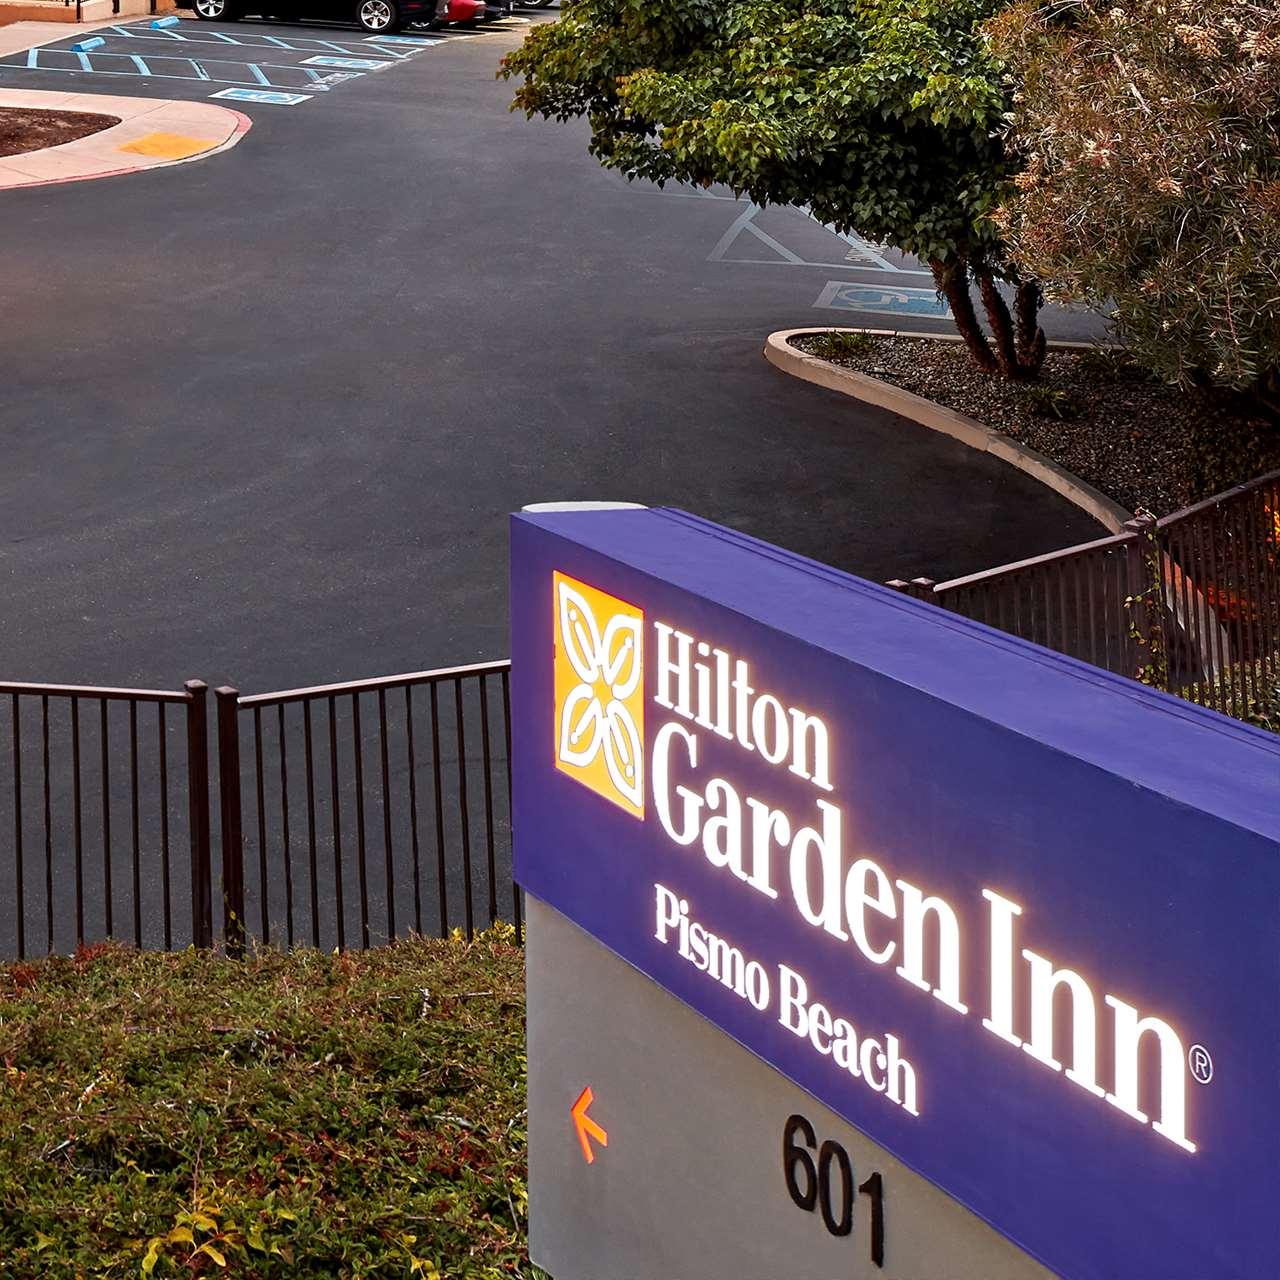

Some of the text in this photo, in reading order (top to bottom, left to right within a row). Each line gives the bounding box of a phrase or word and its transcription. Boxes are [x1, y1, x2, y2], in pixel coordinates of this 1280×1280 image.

[653, 619, 834, 792] Hilton
[651, 721, 969, 1015] Garden
[653, 883, 921, 1118] Pismo Beach
[782, 1113, 886, 1270] 601
